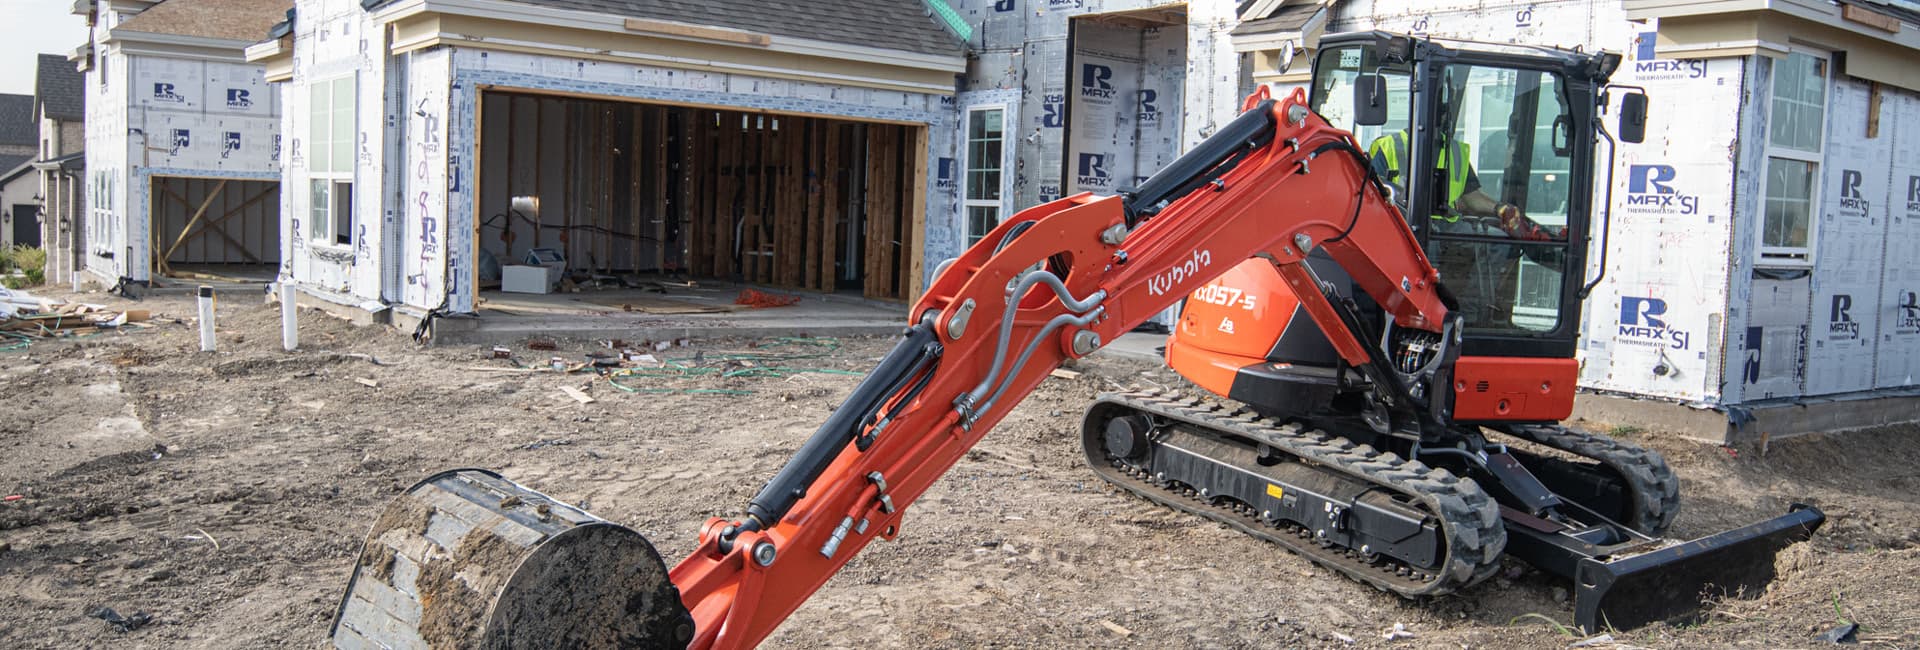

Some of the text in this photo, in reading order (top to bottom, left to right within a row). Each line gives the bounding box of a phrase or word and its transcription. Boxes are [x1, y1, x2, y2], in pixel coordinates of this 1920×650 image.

[1083, 64, 1112, 89] R
[1635, 59, 1708, 78] MAX SI
[227, 88, 250, 103] R
[1082, 88, 1111, 98] MAX
[1079, 153, 1107, 178] R
[1077, 176, 1107, 187] MAX
[1629, 164, 1676, 194] R
[1841, 169, 1862, 199] R
[1627, 195, 1699, 215] MAX SI
[1840, 198, 1861, 209] MAX
[422, 217, 437, 243] R
[1148, 249, 1211, 296] Kubota
[1620, 296, 1668, 329] R
[1831, 295, 1852, 322] R
[1619, 326, 1689, 350] MAX SI
[1830, 322, 1850, 333] MAX
[1743, 326, 1763, 385] R
